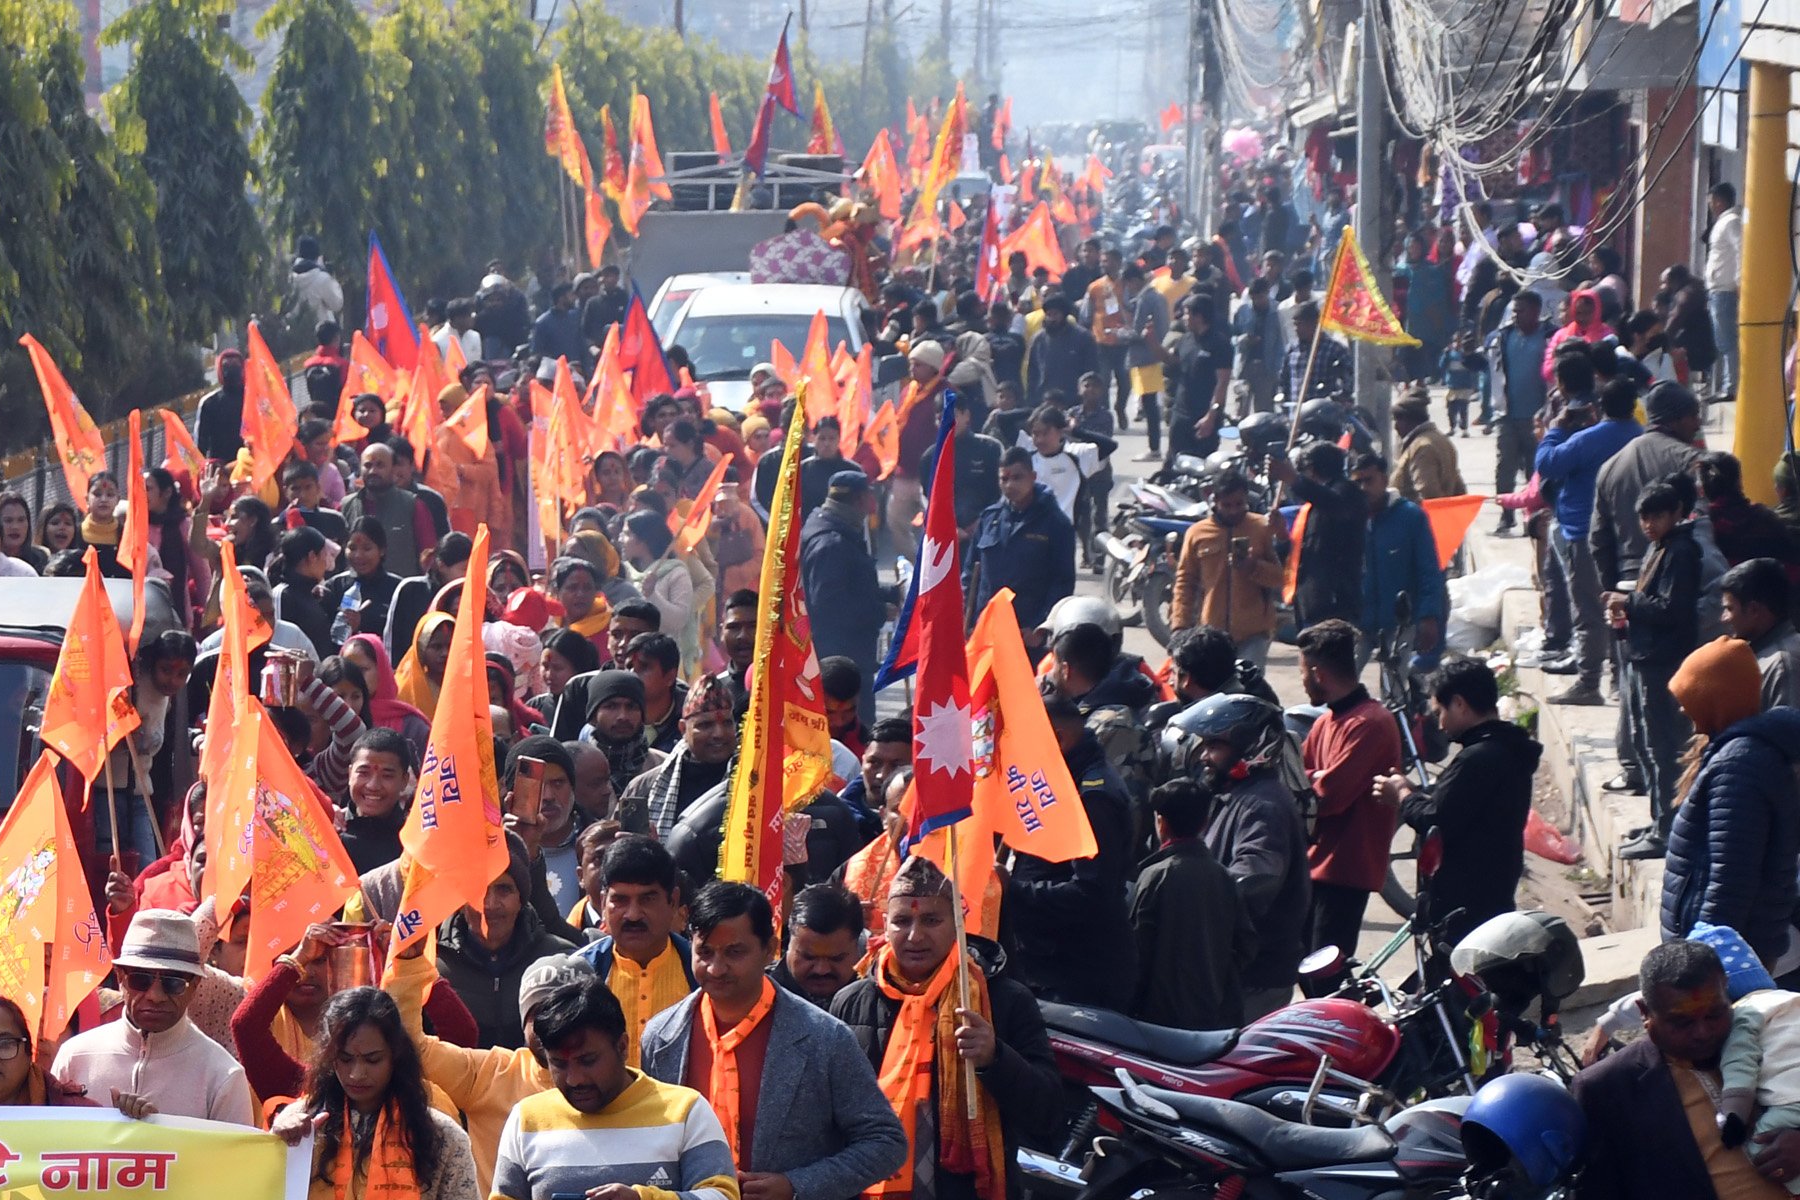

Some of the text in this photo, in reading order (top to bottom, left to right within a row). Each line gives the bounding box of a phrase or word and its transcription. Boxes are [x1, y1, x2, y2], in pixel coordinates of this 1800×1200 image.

[440, 754, 462, 804] जय
[1006, 764, 1043, 833] श्री राम
[1031, 768, 1057, 809] जय
[420, 781, 438, 831] राम
[40, 1152, 176, 1191] नाम
